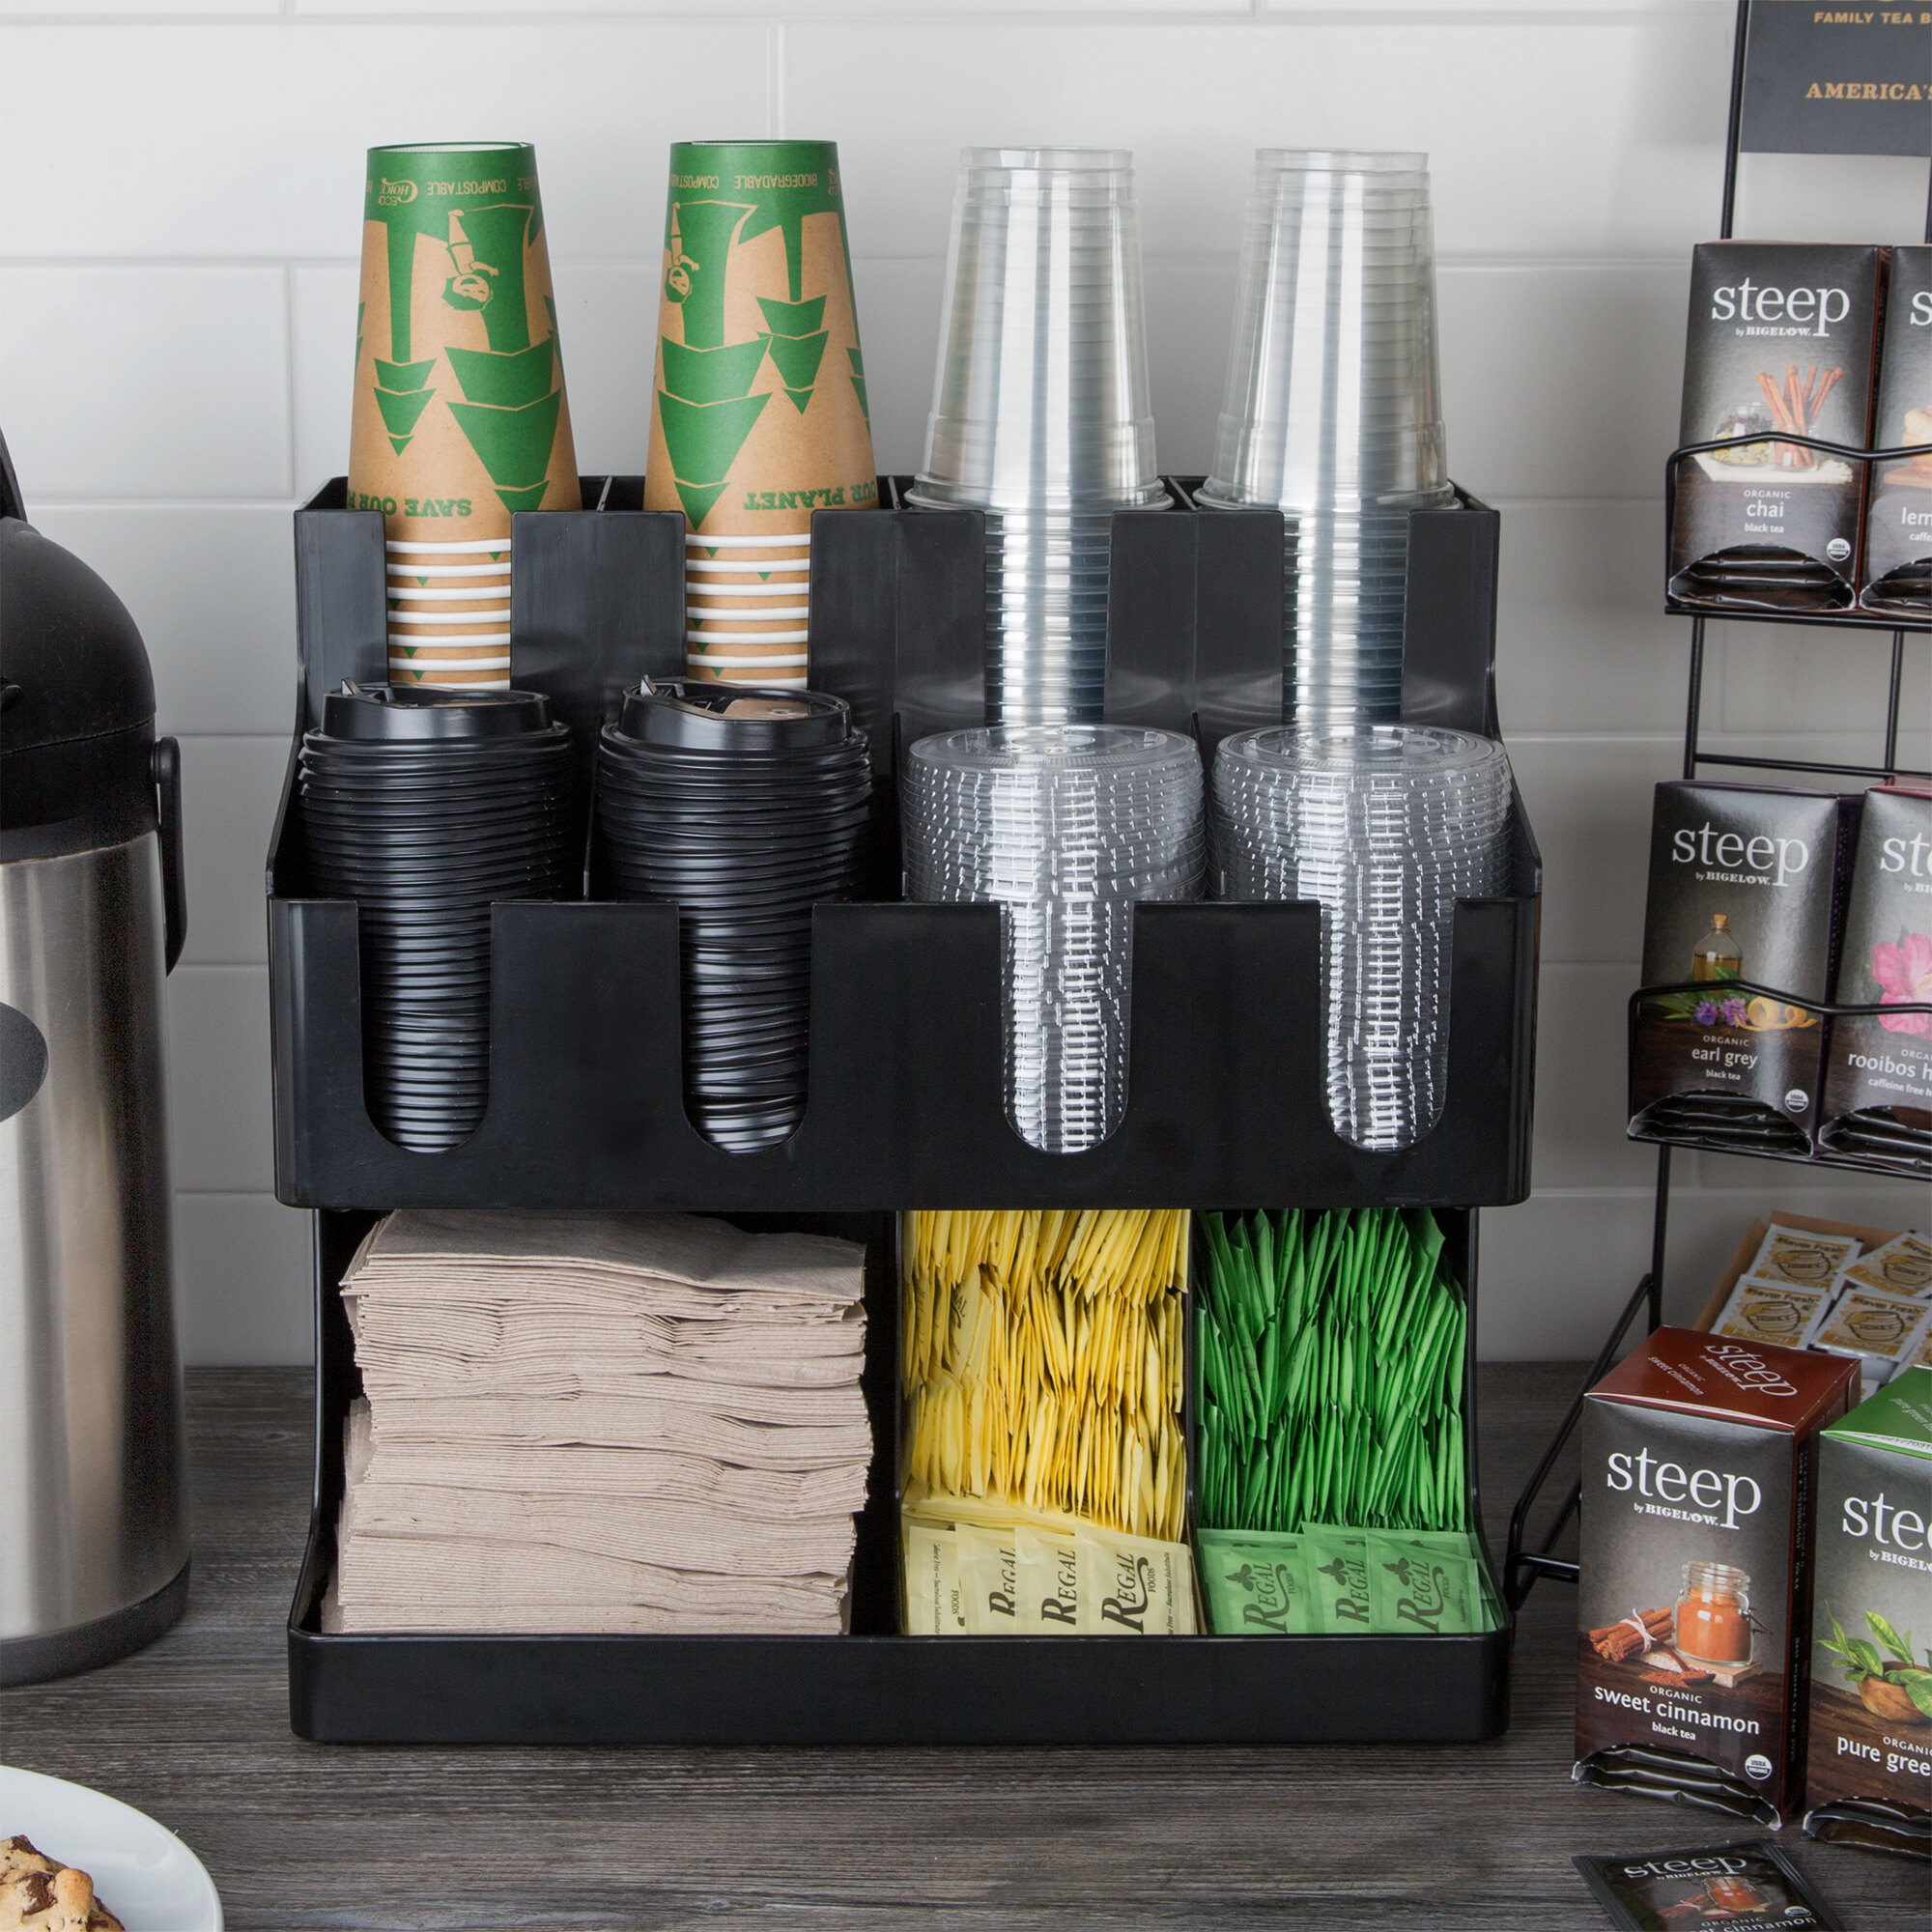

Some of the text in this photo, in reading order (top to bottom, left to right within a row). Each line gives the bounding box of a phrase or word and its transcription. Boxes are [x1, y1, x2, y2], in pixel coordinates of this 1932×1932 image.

[1813, 12, 1875, 24] FAMILY
[1881, 12, 1914, 24] TEA
[426, 179, 507, 196] COMPOSTABLE
[734, 173, 818, 189] BIODEGRADABLE
[378, 196, 398, 207] ECO
[1711, 277, 1851, 337] steep
[743, 487, 846, 511] PLANET
[1743, 489, 1792, 499] ORGANIC
[404, 497, 472, 518] SAVE
[1746, 499, 1785, 519] chai
[1744, 523, 1785, 533] black tea
[1672, 821, 1809, 887] steep
[1880, 832, 1932, 876] st
[1695, 871, 1706, 881] by
[1703, 1036, 1749, 1047] ORGANIC
[1691, 1047, 1759, 1069] earl grey
[1847, 1053, 1917, 1078] rooibos
[1900, 1049, 1932, 1061] ORGA
[1705, 1069, 1741, 1081] black tea
[1868, 1078, 1905, 1092] caffeine
[1906, 1083, 1924, 1095] free
[1704, 1345, 1799, 1397] steep
[1606, 1447, 1762, 1530] steep
[1634, 1502, 1644, 1514] by
[1842, 1492, 1932, 1550] ste
[1869, 1548, 1880, 1561] by
[1041, 1549, 1077, 1626] REGAL
[1147, 1567, 1156, 1593] FOODS
[1101, 1553, 1149, 1634] REGAL
[1242, 1563, 1291, 1634] REGAL
[1335, 1558, 1370, 1624] REGAL
[1397, 1559, 1444, 1633] REGAL
[951, 1589, 960, 1615] FOODS
[1649, 1685, 1703, 1704] ORGANIC
[1594, 1686, 1760, 1735] sweet cinnamon
[1652, 1721, 1697, 1740] black tea
[1837, 1736, 1881, 1762] pure
[1882, 1736, 1932, 1756] ORGANI
[1624, 1857, 1747, 1879] steep
[1701, 1917, 1765, 1927] ORGANIC
[1723, 1918, 1817, 1932] cinnamon
